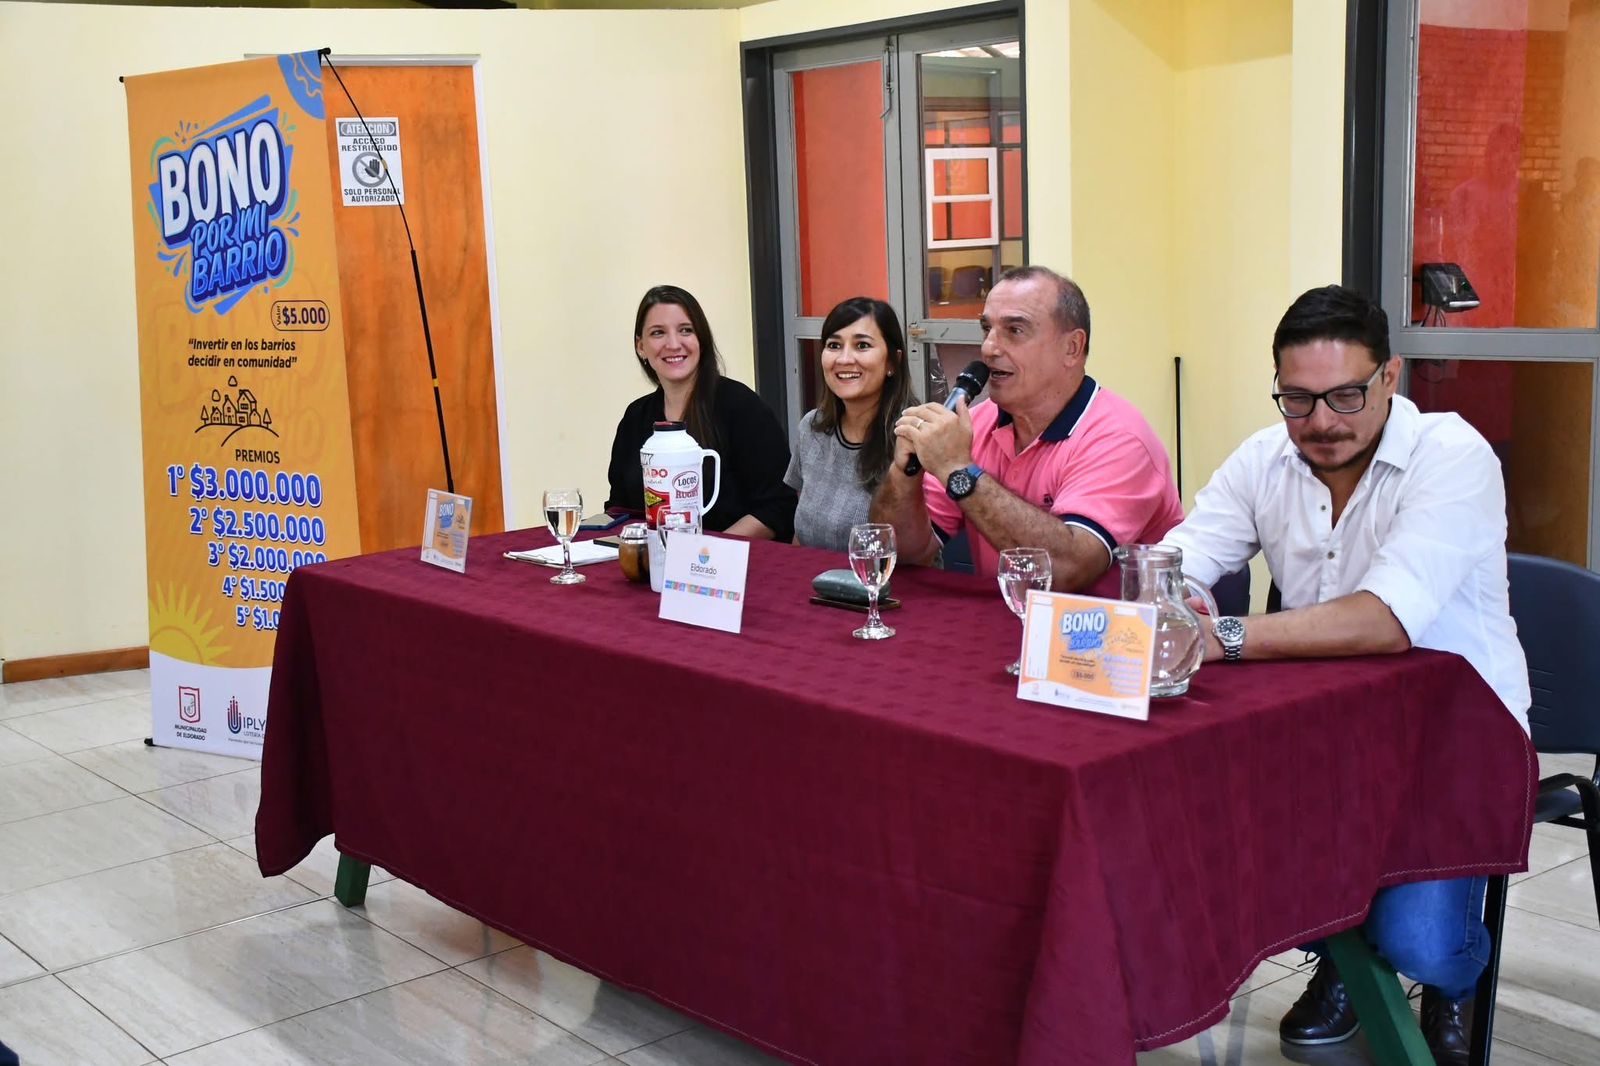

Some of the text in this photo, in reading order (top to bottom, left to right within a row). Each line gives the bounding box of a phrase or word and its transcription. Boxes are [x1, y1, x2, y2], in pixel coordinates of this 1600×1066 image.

[158, 120, 284, 240] BONO
[191, 202, 267, 257] POR MI
[192, 228, 284, 298] BARRIO
[282, 306, 327, 326] $5.000
[230, 339, 242, 349] en
[244, 338, 258, 350] los
[260, 338, 295, 350] barrios
[188, 355, 220, 366] decidir
[223, 357, 235, 367] en
[235, 448, 281, 464] PREMIOS
[190, 463, 322, 507] $3.000.000
[213, 506, 326, 546] $2.500.000
[690, 563, 716, 574] Eldorado
[1062, 611, 1105, 635] BONO
